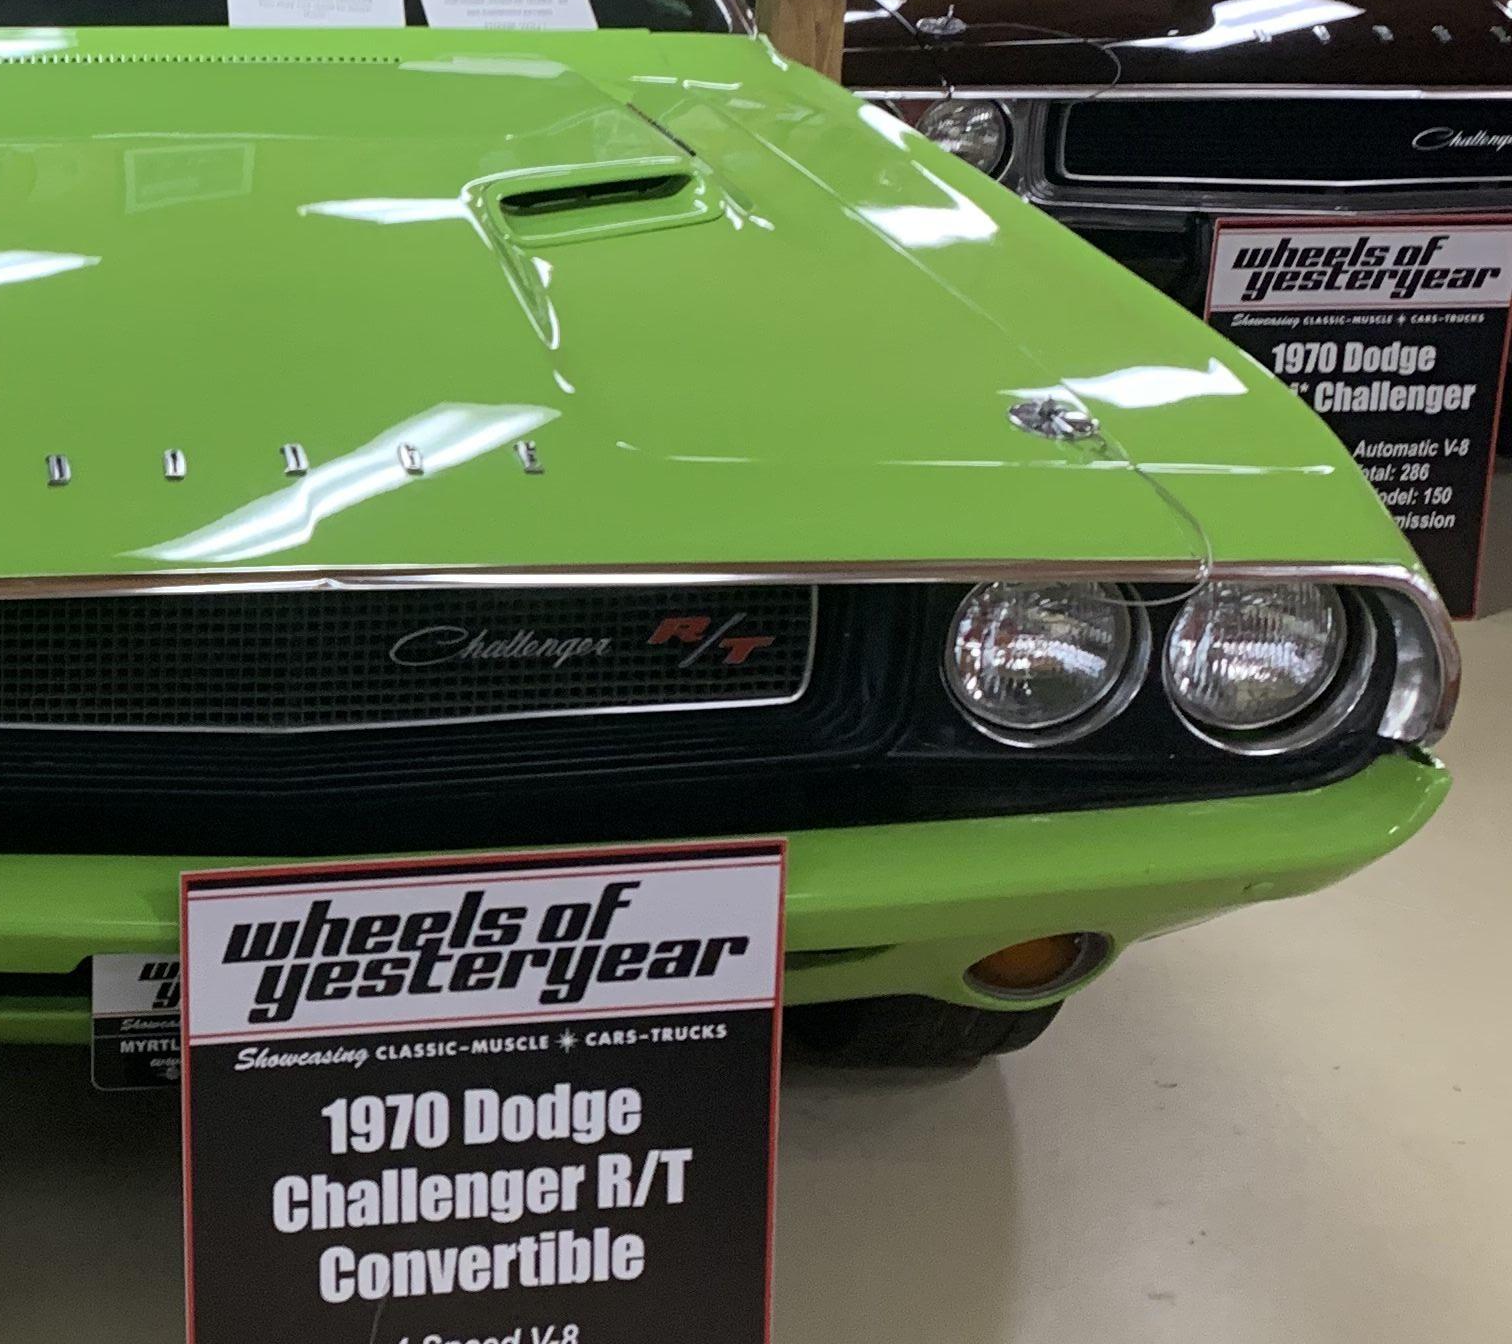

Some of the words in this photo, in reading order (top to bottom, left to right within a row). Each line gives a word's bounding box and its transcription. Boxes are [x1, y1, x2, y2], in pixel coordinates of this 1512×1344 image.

[1232, 237, 1391, 269] wheels
[1393, 235, 1450, 267] of
[1240, 261, 1501, 301] yesteryear
[1272, 342, 1337, 374] 1970
[1342, 341, 1437, 376] Dodge
[1313, 380, 1477, 414] Challenger
[1353, 440, 1439, 458] Automatic
[1444, 438, 1471, 456] V-8
[1362, 463, 1396, 482] otal:
[1400, 463, 1430, 481] 286
[1376, 488, 1419, 506] odel:
[1424, 486, 1453, 505] 150
[388, 624, 614, 668] Challenger
[646, 612, 776, 669] R/T
[221, 890, 528, 965] wheels
[536, 880, 641, 944] of
[246, 936, 750, 1025] yesteryear
[119, 1038, 180, 1054] MYRTL
[233, 1046, 369, 1072] Showcasing
[374, 1034, 550, 1060] CLASSIC-MUSCLE
[584, 1023, 729, 1047] CARS-TRUCKS
[321, 1090, 450, 1155] 1970
[463, 1082, 642, 1145] Dodge
[272, 1161, 597, 1234] Challenger
[597, 1147, 693, 1209] R/T
[318, 1227, 646, 1304] Convertible
